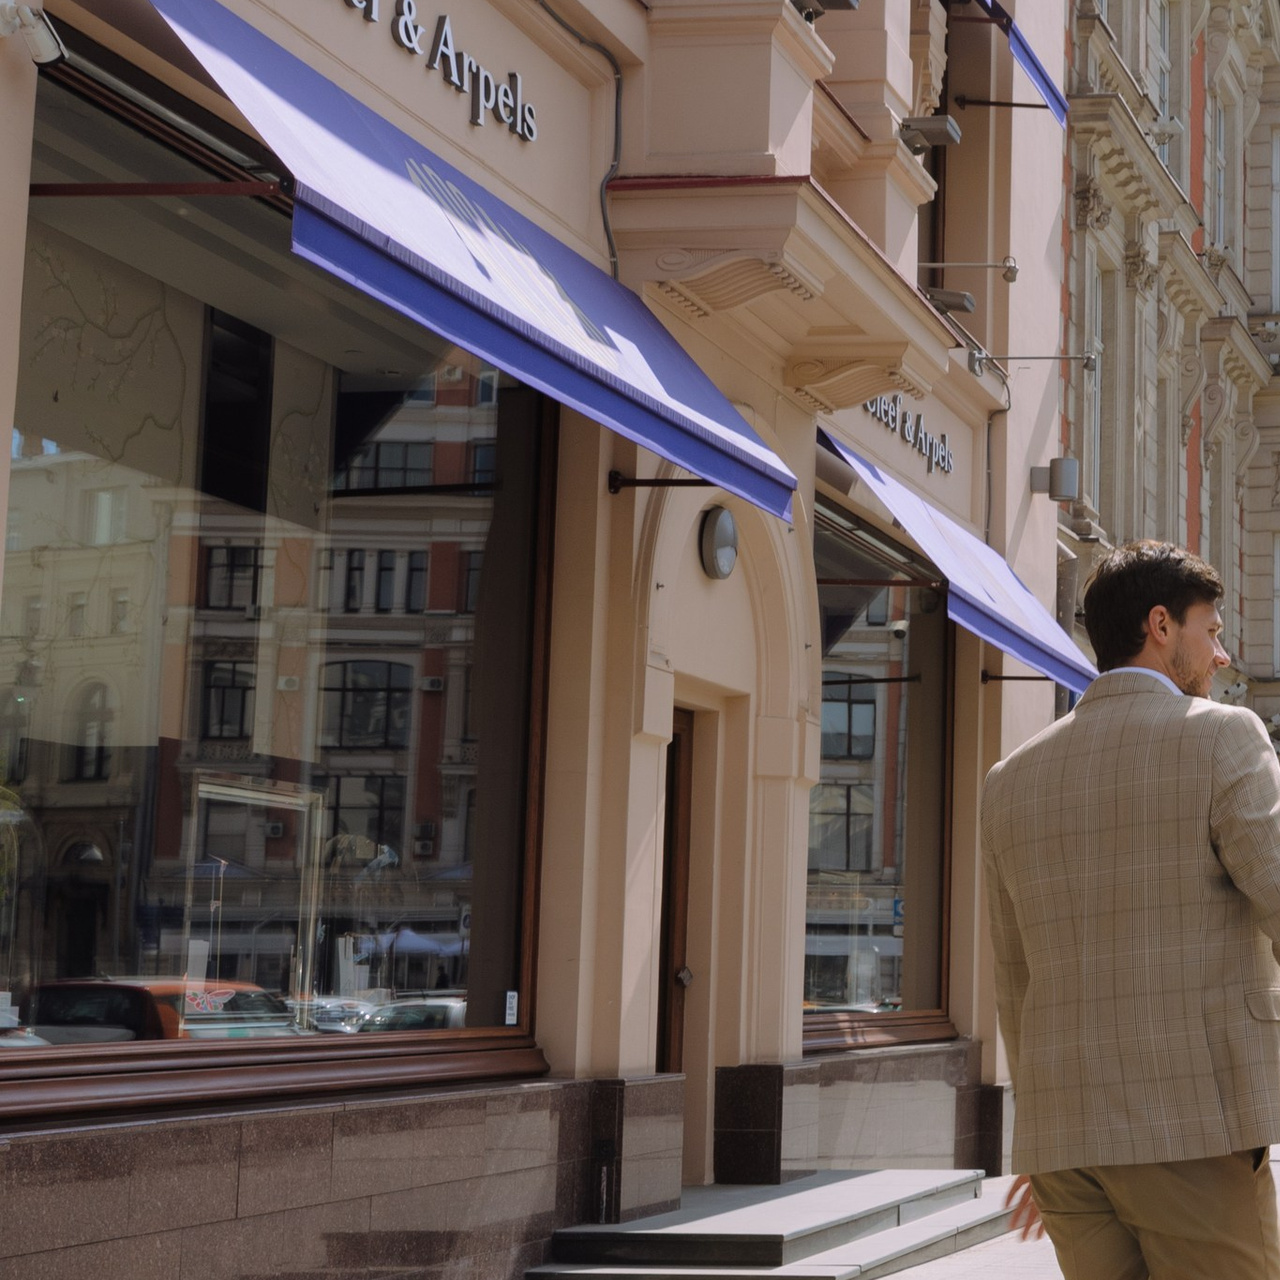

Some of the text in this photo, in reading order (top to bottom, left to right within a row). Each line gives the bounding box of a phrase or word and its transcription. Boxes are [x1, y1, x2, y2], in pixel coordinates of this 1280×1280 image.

[426, 14, 538, 142] Arpels
[901, 411, 914, 443] &
[912, 414, 953, 474] Arpels
